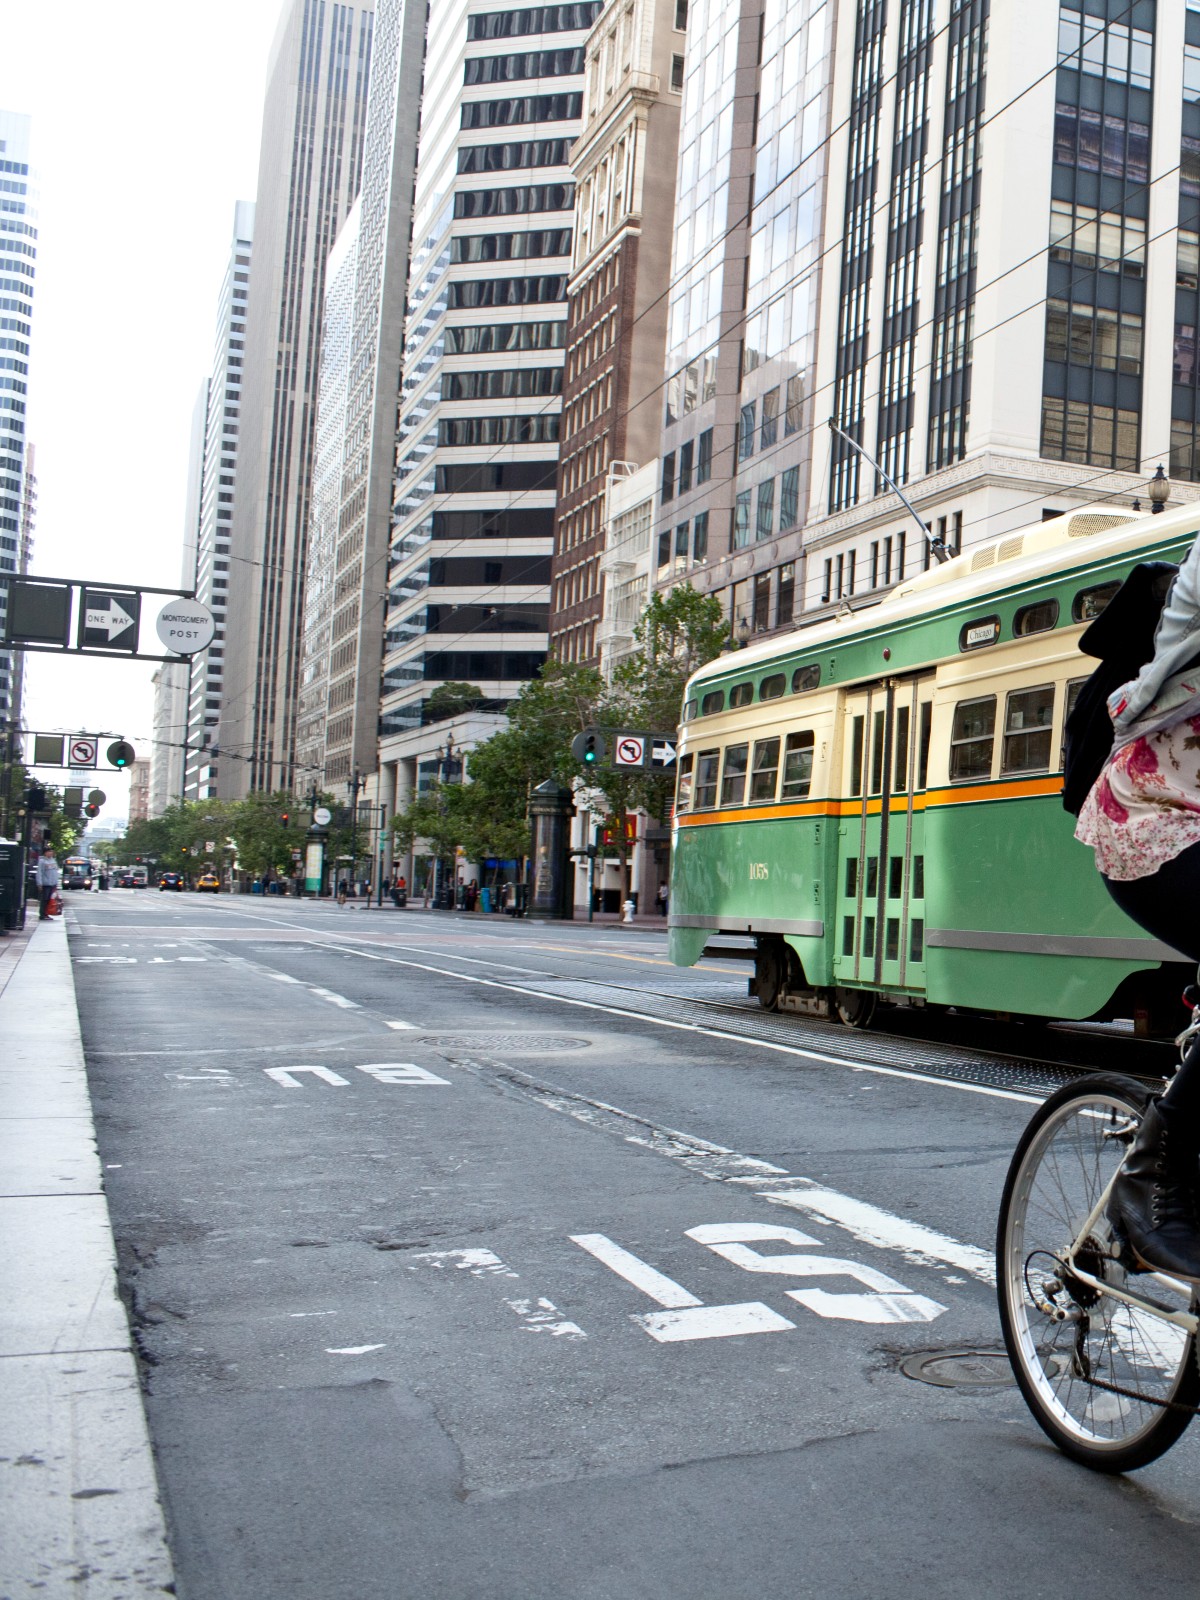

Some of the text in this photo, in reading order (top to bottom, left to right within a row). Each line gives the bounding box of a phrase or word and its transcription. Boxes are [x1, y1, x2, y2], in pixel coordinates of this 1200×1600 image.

[87, 614, 129, 625] ONE WAY
[162, 614, 209, 625] MONTGOMERY
[169, 629, 199, 638] POST
[969, 629, 992, 641] Chicago
